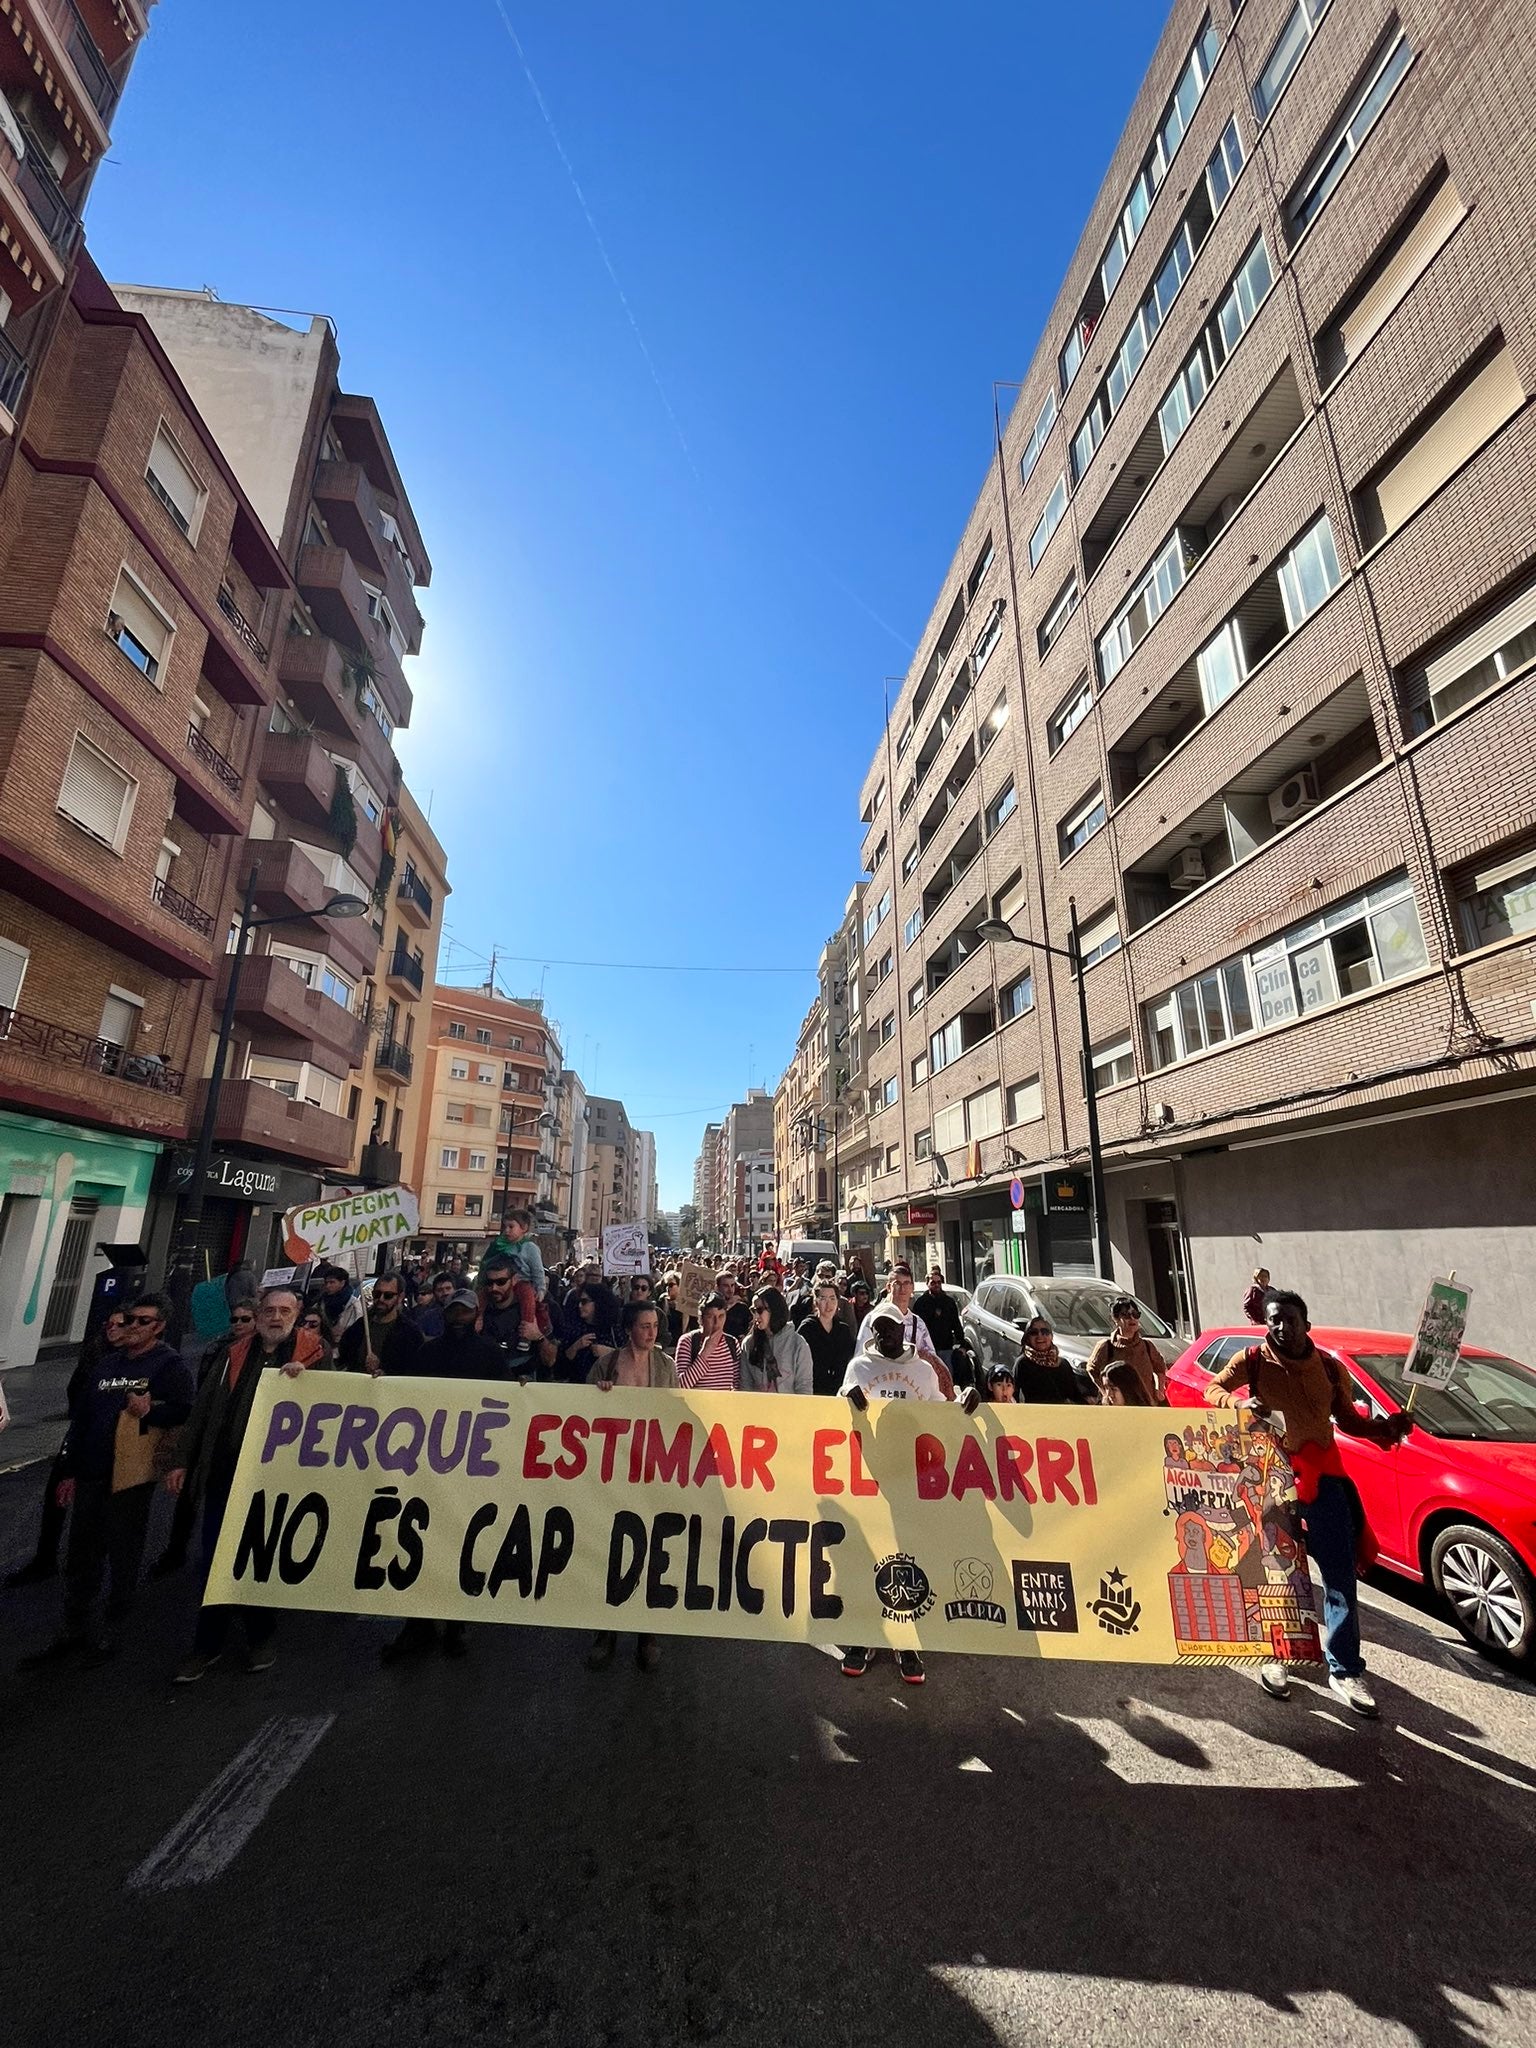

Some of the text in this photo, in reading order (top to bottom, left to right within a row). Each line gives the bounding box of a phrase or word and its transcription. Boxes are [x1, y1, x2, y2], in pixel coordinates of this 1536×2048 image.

[1259, 957, 1321, 996] Clínca
[219, 1160, 276, 1195] Laguna
[302, 1191, 400, 1230] PROTEGIM
[316, 1213, 410, 1253] L'HORTA
[104, 1279, 117, 1292] P
[522, 1414, 778, 1492] ESTIMAR
[812, 1428, 880, 1496] EL
[915, 1432, 1099, 1506] BARRI
[1166, 1469, 1203, 1488] AIGUA
[233, 1489, 330, 1585] NO
[459, 1502, 575, 1600] CAP
[606, 1510, 846, 1619] DELICTE
[873, 1552, 915, 1573] CUIDEM
[1021, 1572, 1066, 1589] ENTRE
[881, 1588, 938, 1624] BENIMACLET
[1022, 1589, 1067, 1612] BARRIS
[1026, 1610, 1058, 1627] VLC
[1230, 1645, 1249, 1653] VIDA
